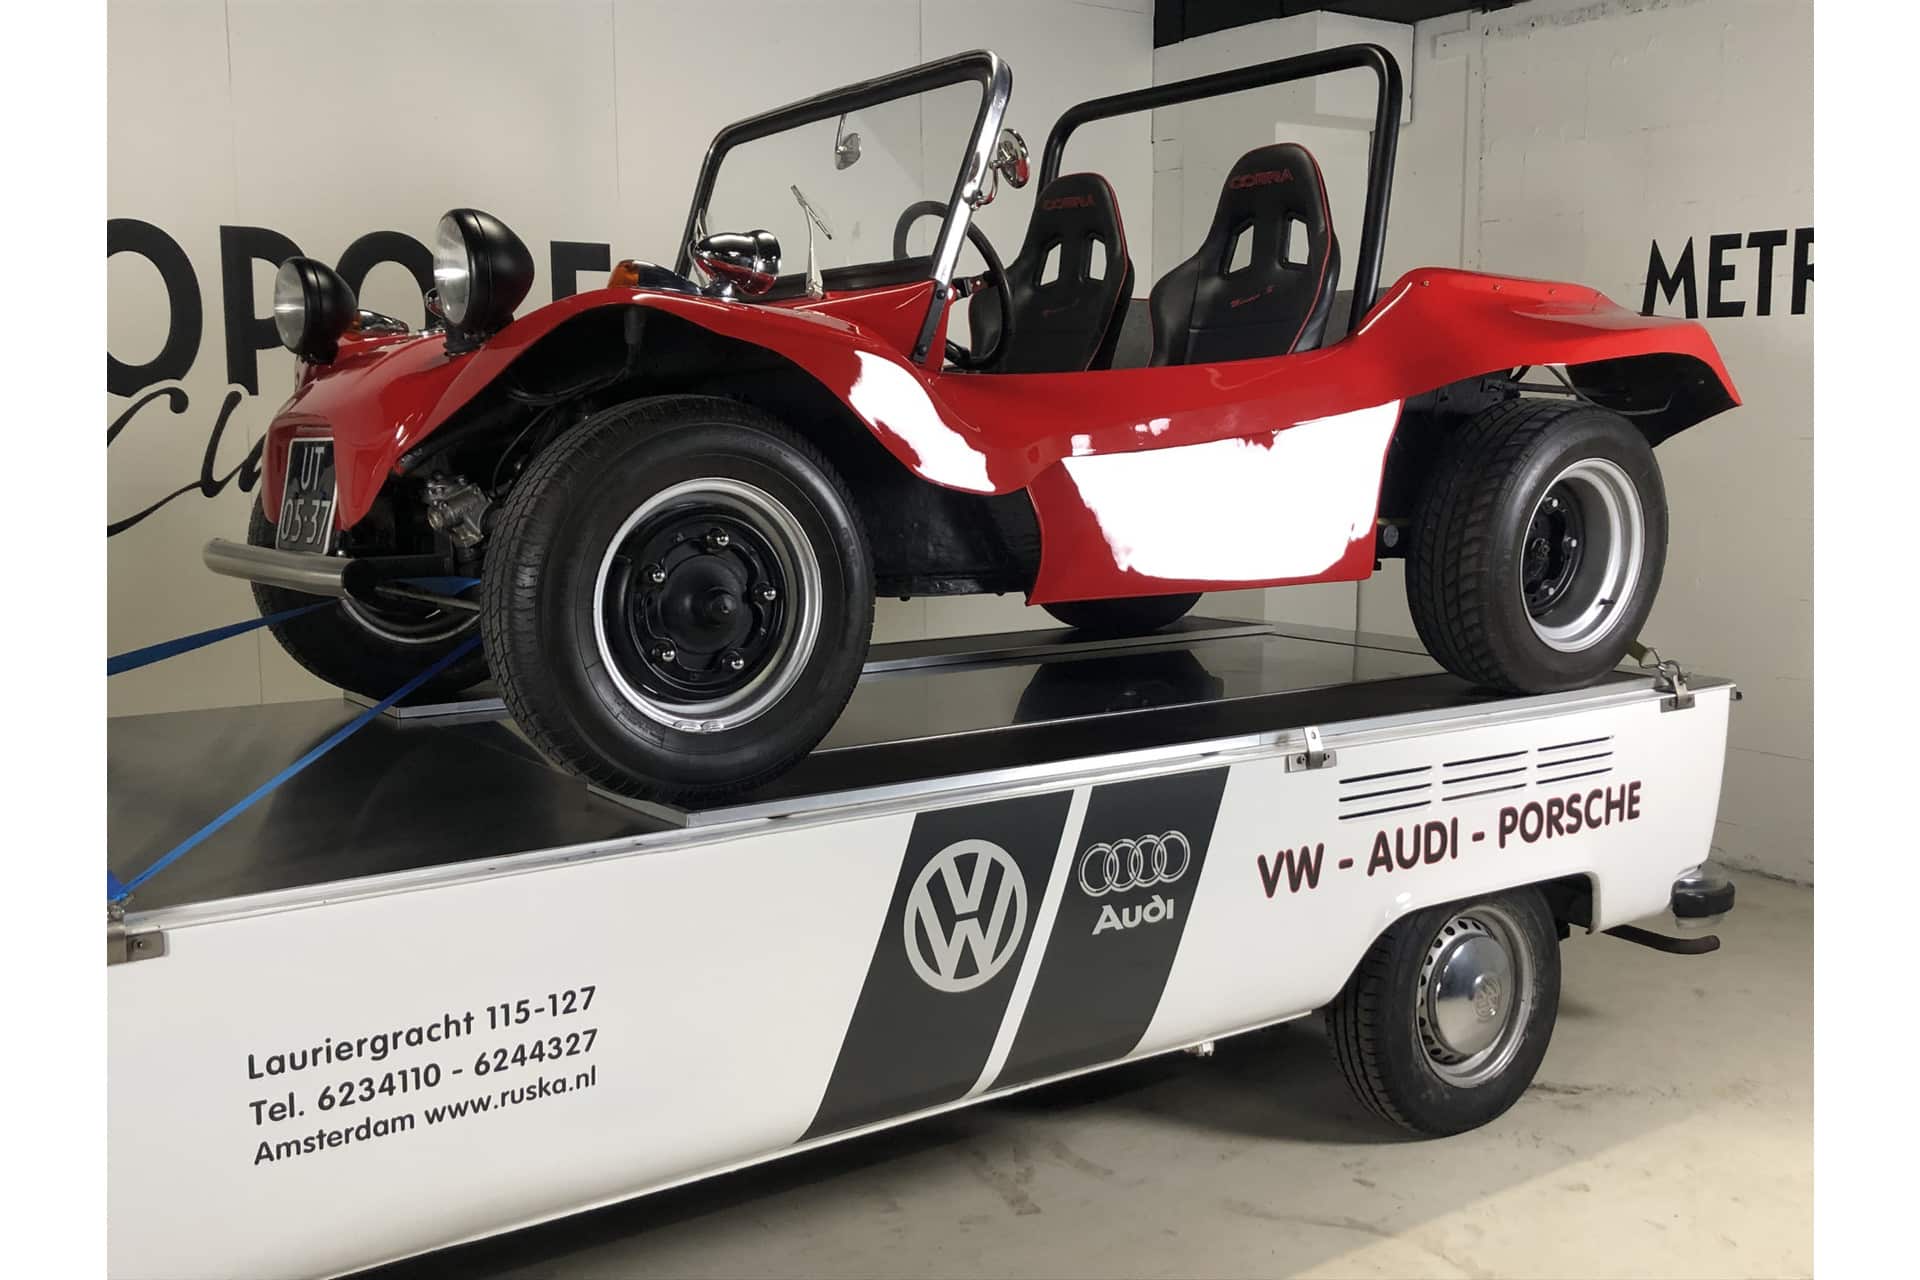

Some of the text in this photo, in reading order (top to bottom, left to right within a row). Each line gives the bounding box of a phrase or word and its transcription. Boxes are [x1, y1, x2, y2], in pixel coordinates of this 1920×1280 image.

[301, 446, 325, 491] UT
[1257, 842, 1325, 899] VW
[1367, 817, 1459, 876] AUDI
[1499, 780, 1642, 849] PORSCHE
[1092, 894, 1174, 935] Audi
[247, 985, 597, 1080] Lauriergracht 115-127
[249, 1092, 305, 1126] Tel.
[317, 1063, 441, 1111] 6234110
[474, 1028, 598, 1076] 6244327
[254, 1065, 597, 1166] Amsterdam www.ruska.nl
